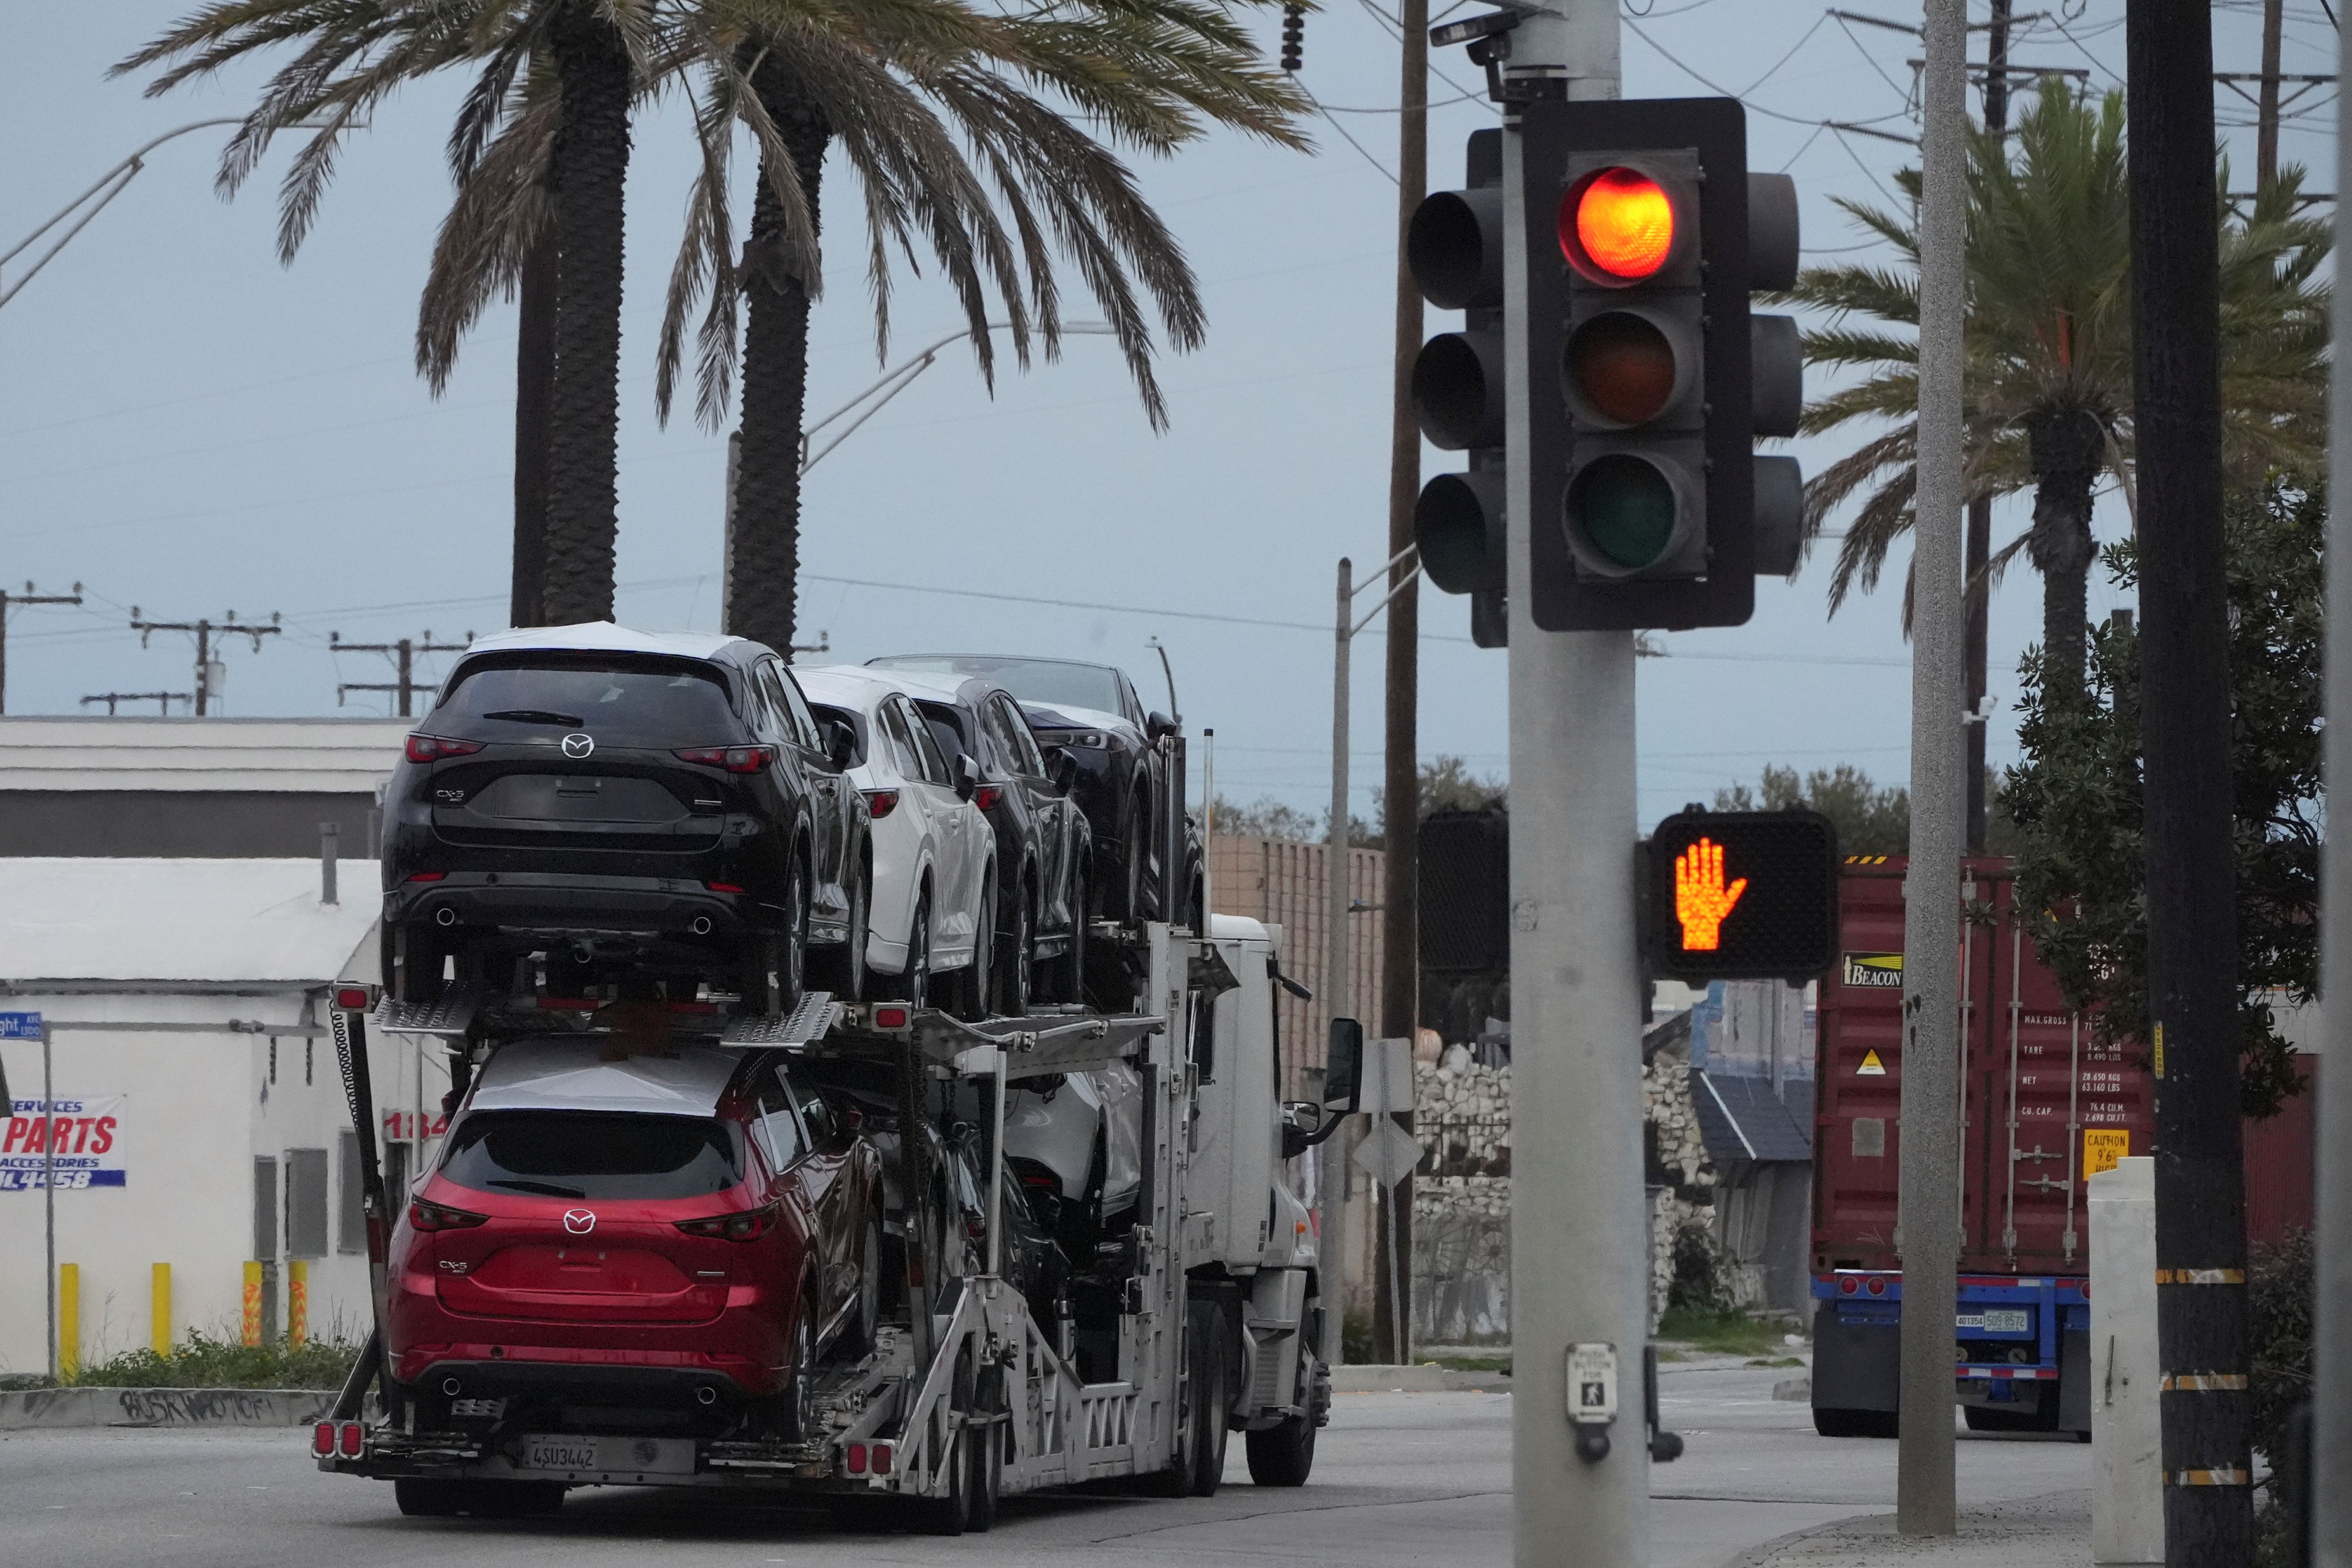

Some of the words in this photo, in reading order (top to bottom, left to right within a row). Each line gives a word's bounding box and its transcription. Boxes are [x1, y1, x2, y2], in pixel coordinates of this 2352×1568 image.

[2024, 1046, 2043, 1055] TARE
[2082, 1073, 2106, 1081] 28.650
[2090, 1103, 2105, 1112] 76.4
[2, 1116, 117, 1154] PARTS
[2088, 1135, 2125, 1146] CAUTION
[439, 1261, 467, 1269] CX-5
[533, 1448, 593, 1466] 4SU3442
